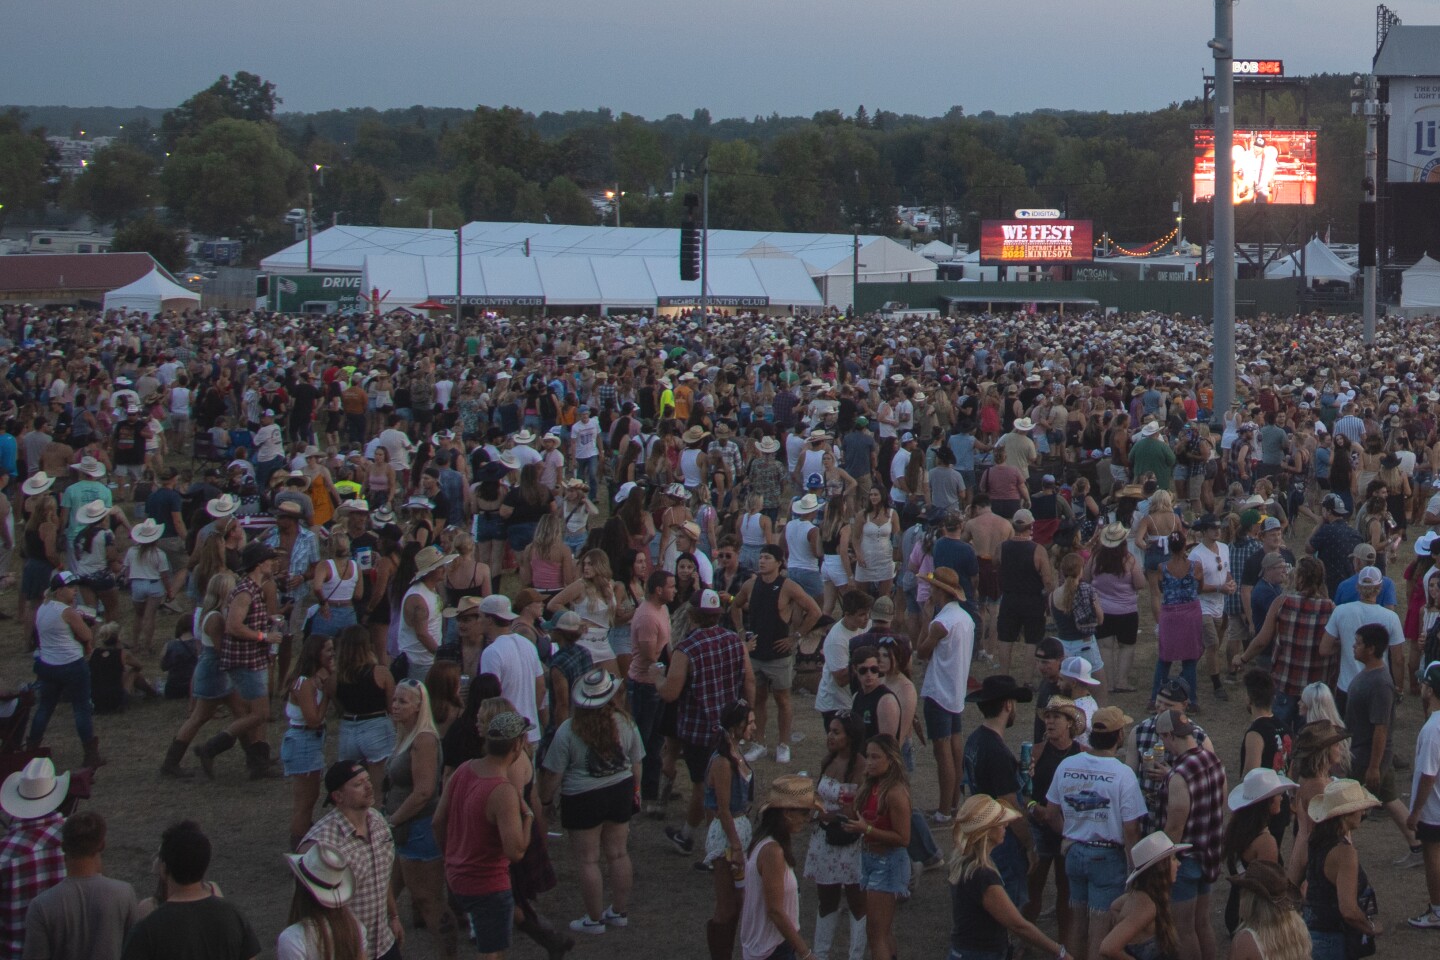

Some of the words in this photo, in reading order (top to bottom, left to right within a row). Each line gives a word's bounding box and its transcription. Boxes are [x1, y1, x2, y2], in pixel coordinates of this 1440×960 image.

[1002, 225, 1027, 239] WE
[1030, 225, 1074, 240] FEST
[1063, 772, 1114, 783] PONTIAC
